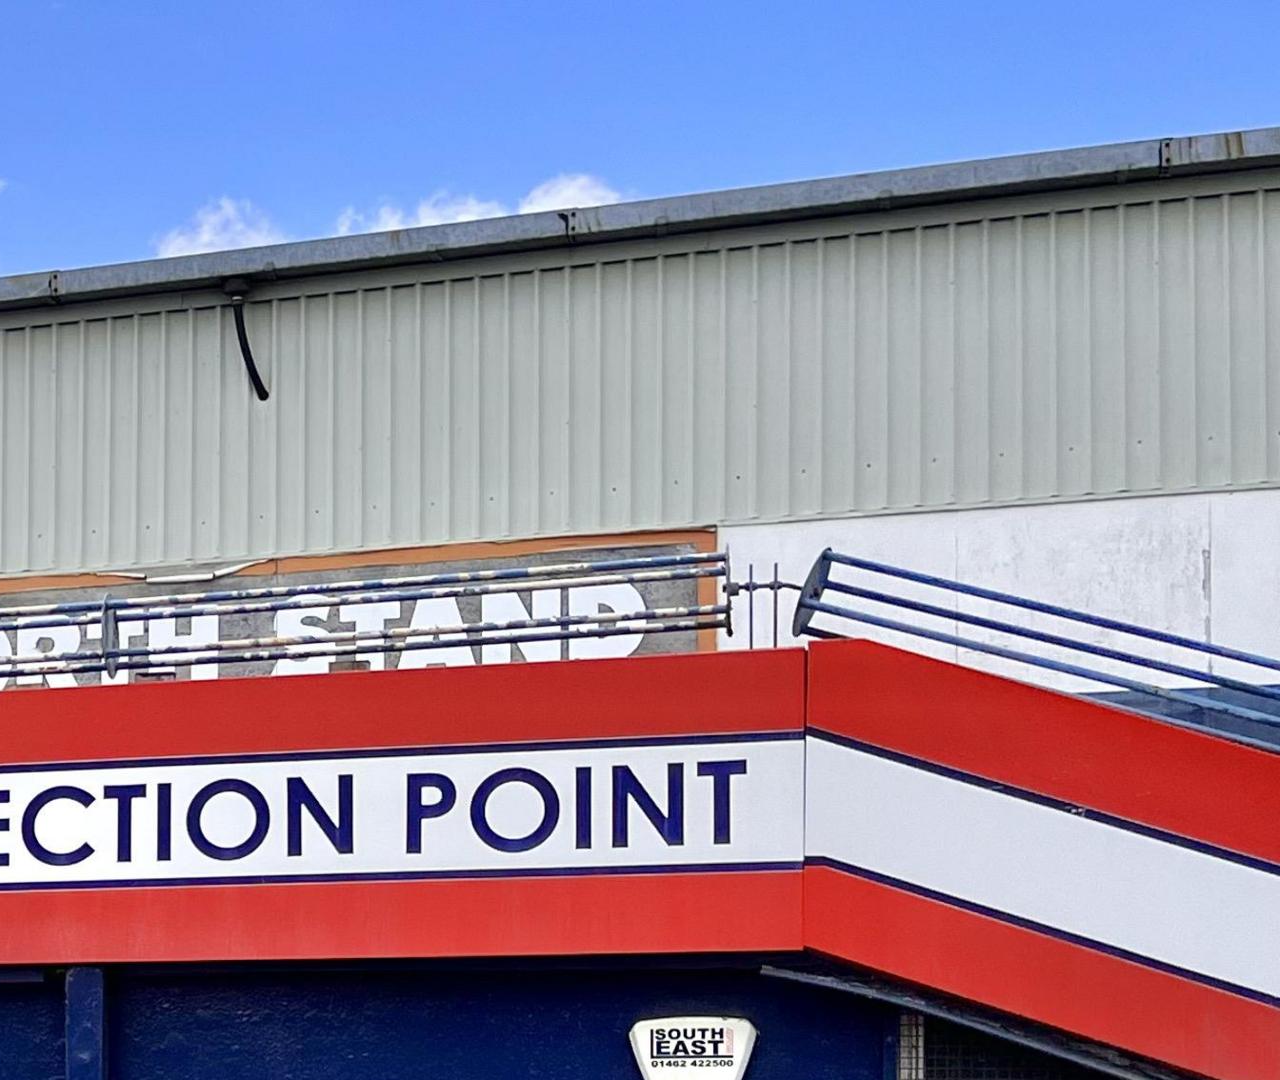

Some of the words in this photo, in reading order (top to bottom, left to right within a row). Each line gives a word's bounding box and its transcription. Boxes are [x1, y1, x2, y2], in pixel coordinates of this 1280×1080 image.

[273, 580, 647, 676] STAND
[405, 759, 748, 856] POINT
[655, 1028, 724, 1040] SOUTH
[656, 1040, 724, 1055] EAST
[651, 1060, 687, 1068] 01462
